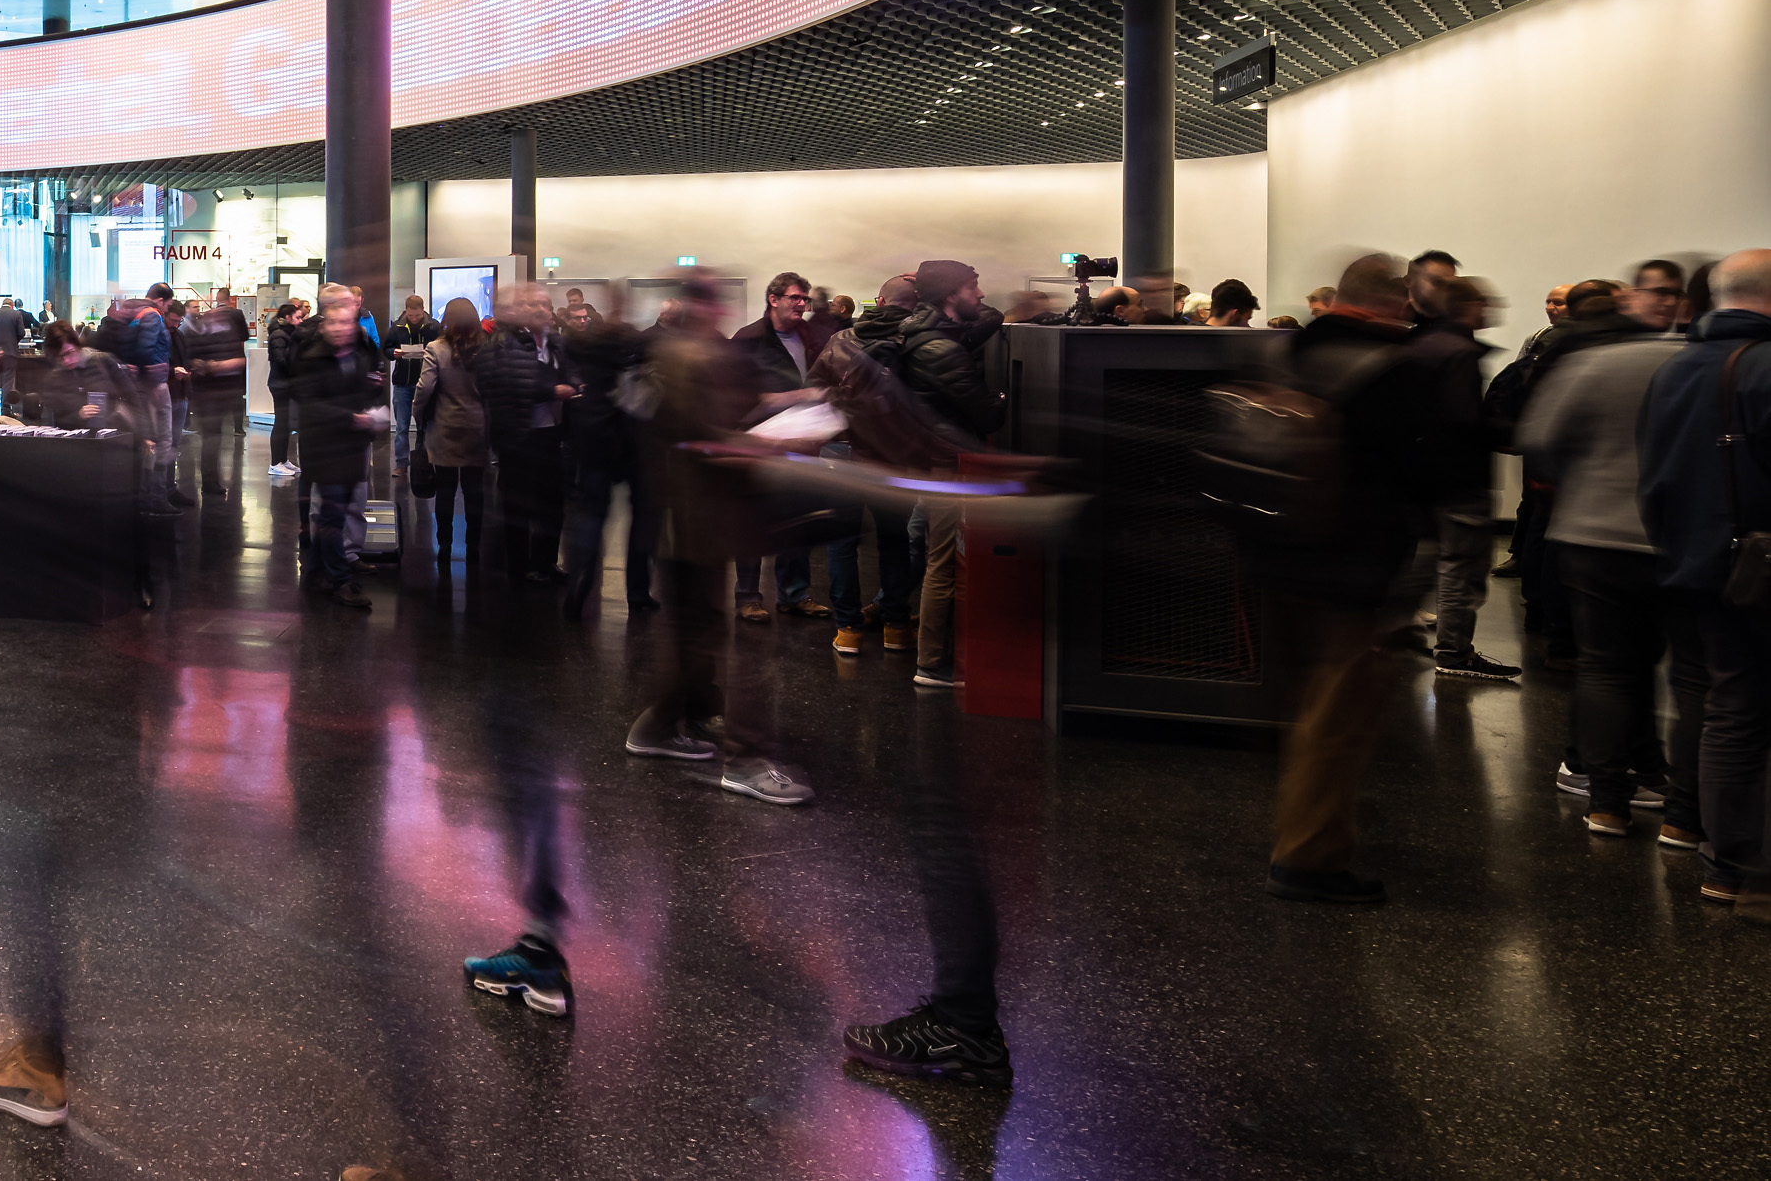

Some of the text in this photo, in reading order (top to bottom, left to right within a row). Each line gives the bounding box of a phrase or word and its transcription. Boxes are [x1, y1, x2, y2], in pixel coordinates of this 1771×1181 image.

[1219, 60, 1262, 95] Information
[153, 245, 222, 260] RAUM 4
